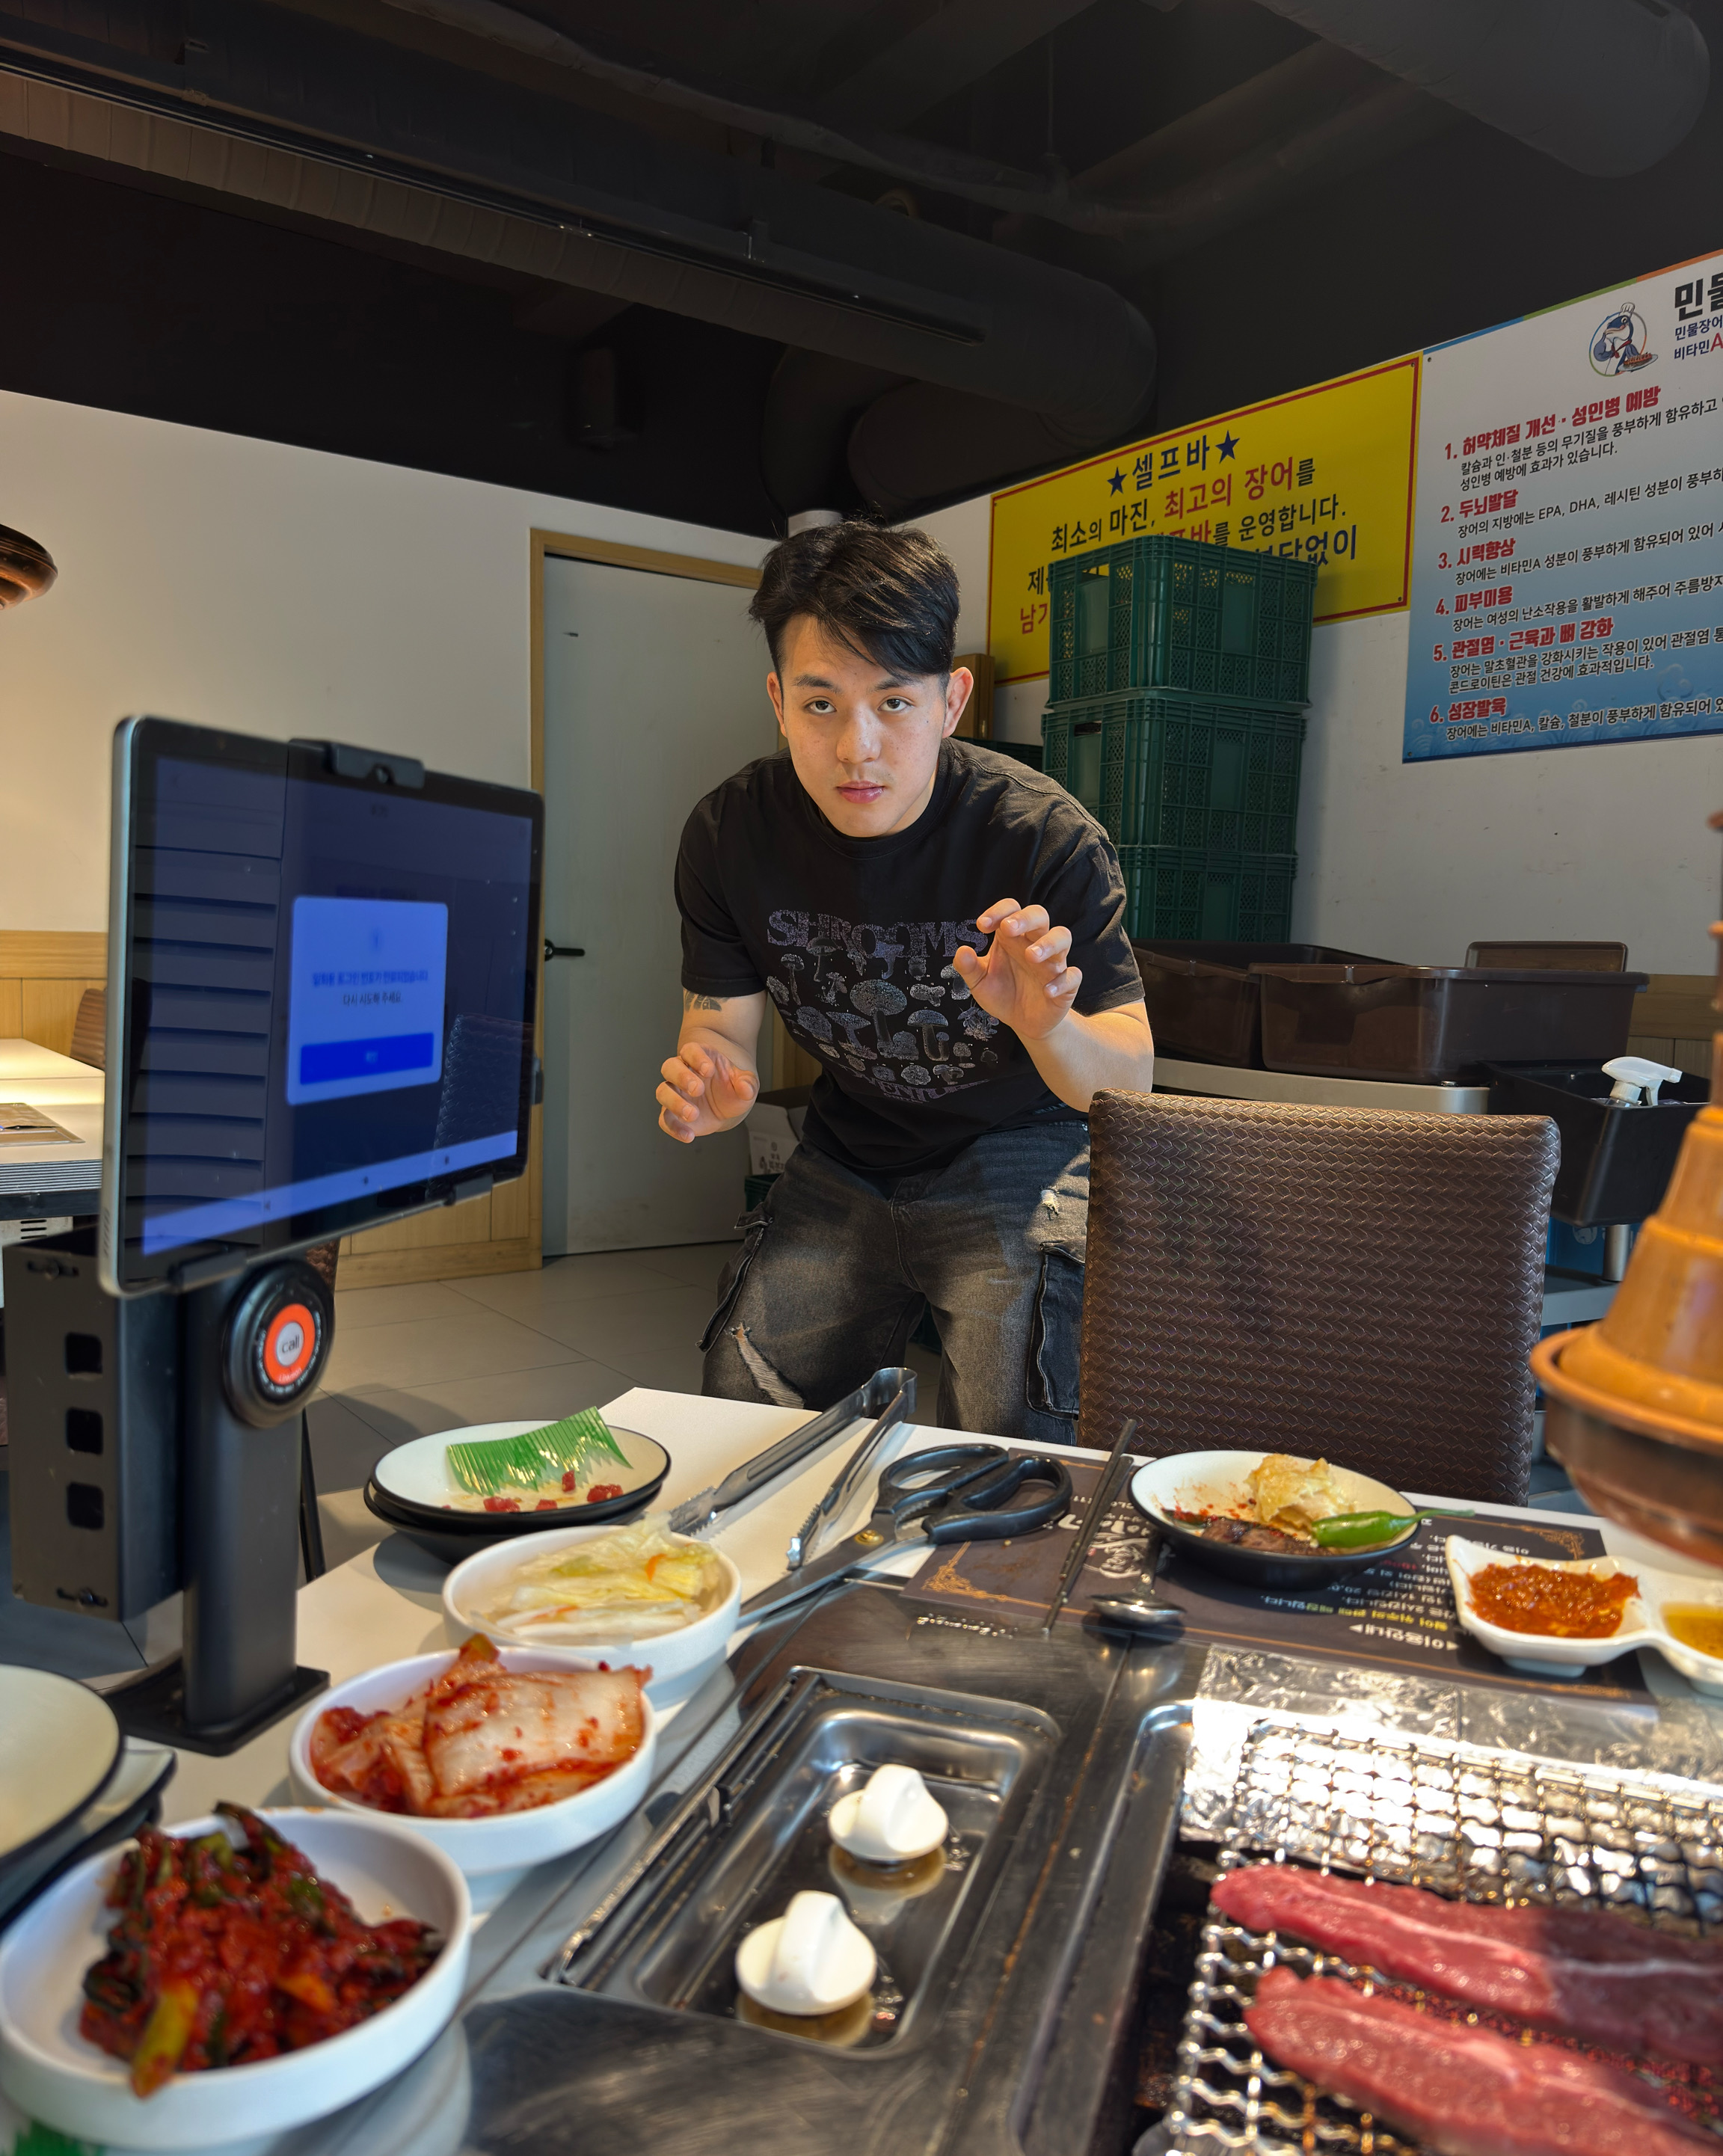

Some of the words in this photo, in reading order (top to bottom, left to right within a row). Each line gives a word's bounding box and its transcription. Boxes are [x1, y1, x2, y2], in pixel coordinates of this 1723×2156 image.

[1674, 332, 1723, 360] 비타민A
[1675, 315, 1723, 341] 민물장어
[1445, 443, 1458, 460] 1.
[1463, 424, 1520, 456] 허약체질
[1526, 414, 1556, 440] 개선
[1572, 396, 1621, 427] 성인병
[1626, 385, 1661, 413] 예방
[1461, 456, 1493, 476] 칼슘과
[1536, 438, 1558, 457] 등의
[1561, 426, 1609, 449] 무기질을
[1612, 411, 1662, 437] 풍부하게
[1665, 399, 1718, 424] 함유하고
[1132, 434, 1210, 491] 셀프바
[1461, 473, 1491, 491] 성인병
[1494, 464, 1527, 482] 예방에
[1529, 454, 1564, 474] 효과가
[1567, 441, 1618, 466] 있습니다.
[1051, 520, 1102, 553] 최소의
[1110, 498, 1155, 536] 마진,
[1164, 473, 1232, 519] 최고의
[1244, 457, 1315, 500] 장어를
[1238, 494, 1346, 542] 운영합니다.
[1440, 506, 1454, 523] 2.
[1459, 489, 1519, 518] 두뇌발달
[1458, 520, 1488, 538] 장어의
[1492, 512, 1535, 530] 지방에는
[1538, 506, 1565, 520] EPA,
[1570, 497, 1600, 513] DHA,
[1604, 486, 1640, 506] 레시틴
[1644, 476, 1682, 498] 성분이
[1438, 553, 1452, 569] 3.
[1456, 538, 1516, 567] 시력향상
[1455, 568, 1496, 586] 장어에는
[1501, 559, 1541, 576] 비타민A
[1544, 550, 1578, 568] 성분이
[1582, 539, 1630, 562] 풍부하게
[1633, 529, 1683, 552] 함유되어
[1688, 523, 1713, 541] 있어
[1435, 598, 1449, 615] 4.
[1455, 586, 1513, 613] 피부미용
[1453, 616, 1484, 632] 장어는
[1487, 609, 1519, 626] 여성의
[1523, 599, 1579, 621] 난소작용을
[1582, 590, 1630, 612] 활발하게
[1633, 583, 1671, 601] 해주어
[1434, 645, 1447, 661] 5.
[1452, 636, 1495, 660] 관절염
[1509, 626, 1556, 651] 근육과
[1559, 623, 1576, 643] 뼈
[1579, 617, 1614, 641] 강화
[1450, 663, 1481, 679] 장어는
[1484, 654, 1538, 674] 말초혈관을
[1541, 646, 1599, 666] 강화시키는
[1602, 639, 1638, 657] 작용이
[1642, 634, 1667, 652] 있어
[1671, 629, 1710, 648] 관절염
[1449, 674, 1512, 694] 콘드로이틴은
[1515, 671, 1537, 686] 관절
[1540, 665, 1573, 683] 건강에
[1577, 655, 1654, 677] 효과적입니다.
[1430, 706, 1444, 723] 6.
[1448, 697, 1506, 722] 성장발육
[1446, 724, 1488, 740] 장어에는
[1490, 719, 1535, 735] 비타민A,
[1538, 715, 1564, 731] 칼슘,
[1568, 710, 1603, 728] 철분이
[1607, 704, 1656, 724] 풍부하게
[1659, 699, 1712, 719] 함유되어
